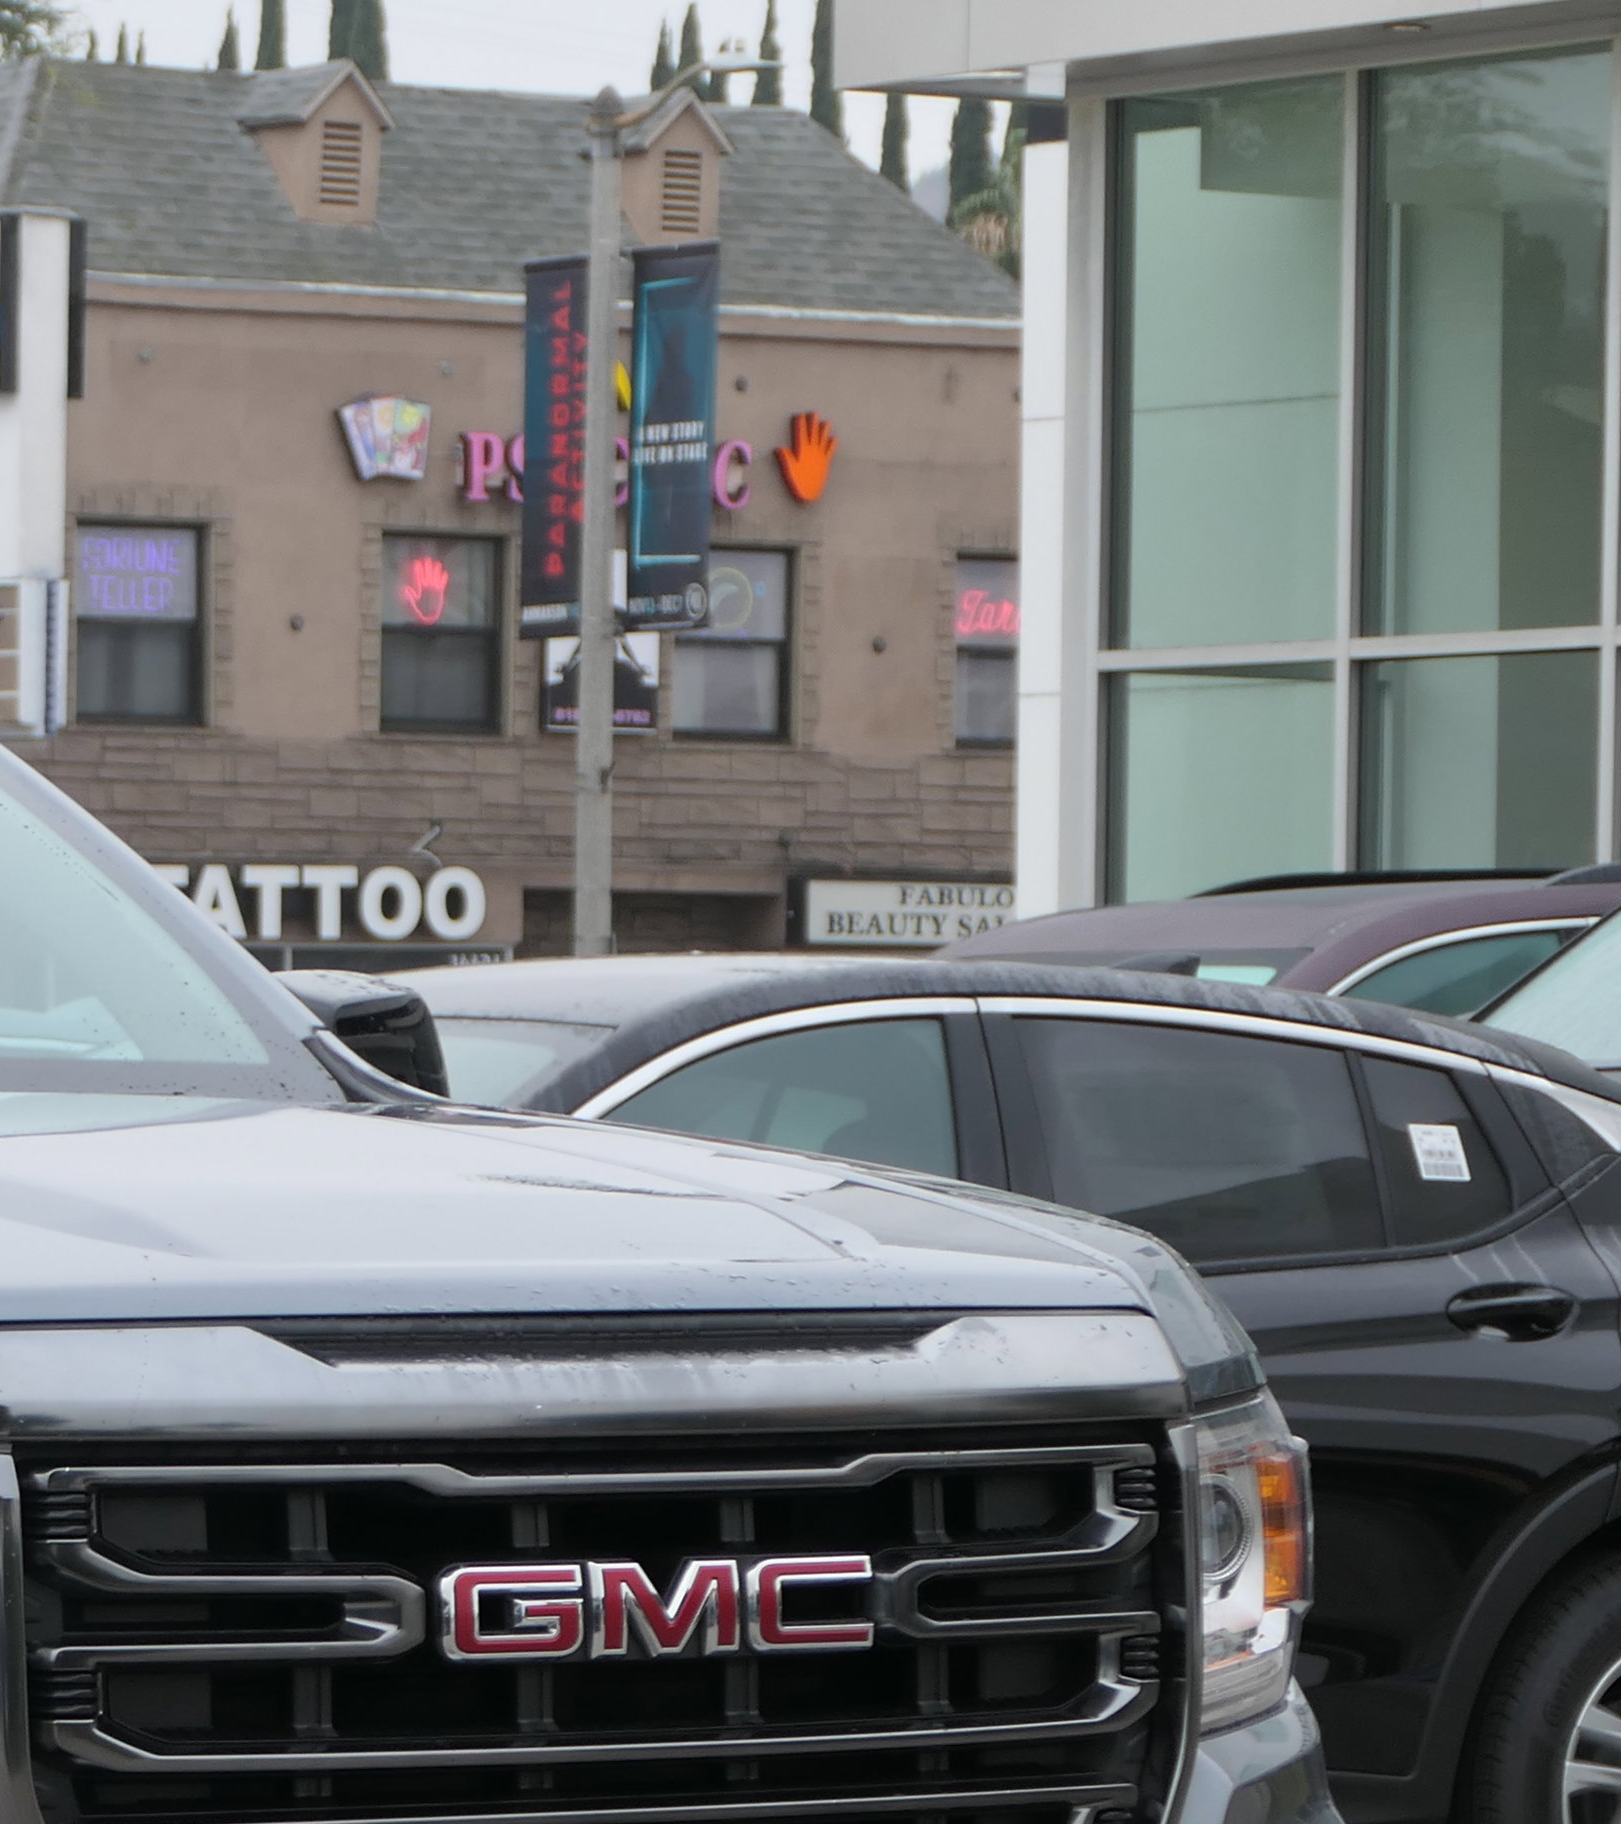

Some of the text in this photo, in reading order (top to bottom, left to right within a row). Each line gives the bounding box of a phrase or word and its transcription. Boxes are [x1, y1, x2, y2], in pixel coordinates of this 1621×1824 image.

[544, 278, 572, 578] PARANORMAL
[954, 590, 1020, 636] Tar
[155, 863, 488, 941] ATTOO
[826, 911, 948, 937] BEAUTY
[899, 885, 1014, 907] FABULO
[440, 1554, 874, 1660] GMC
